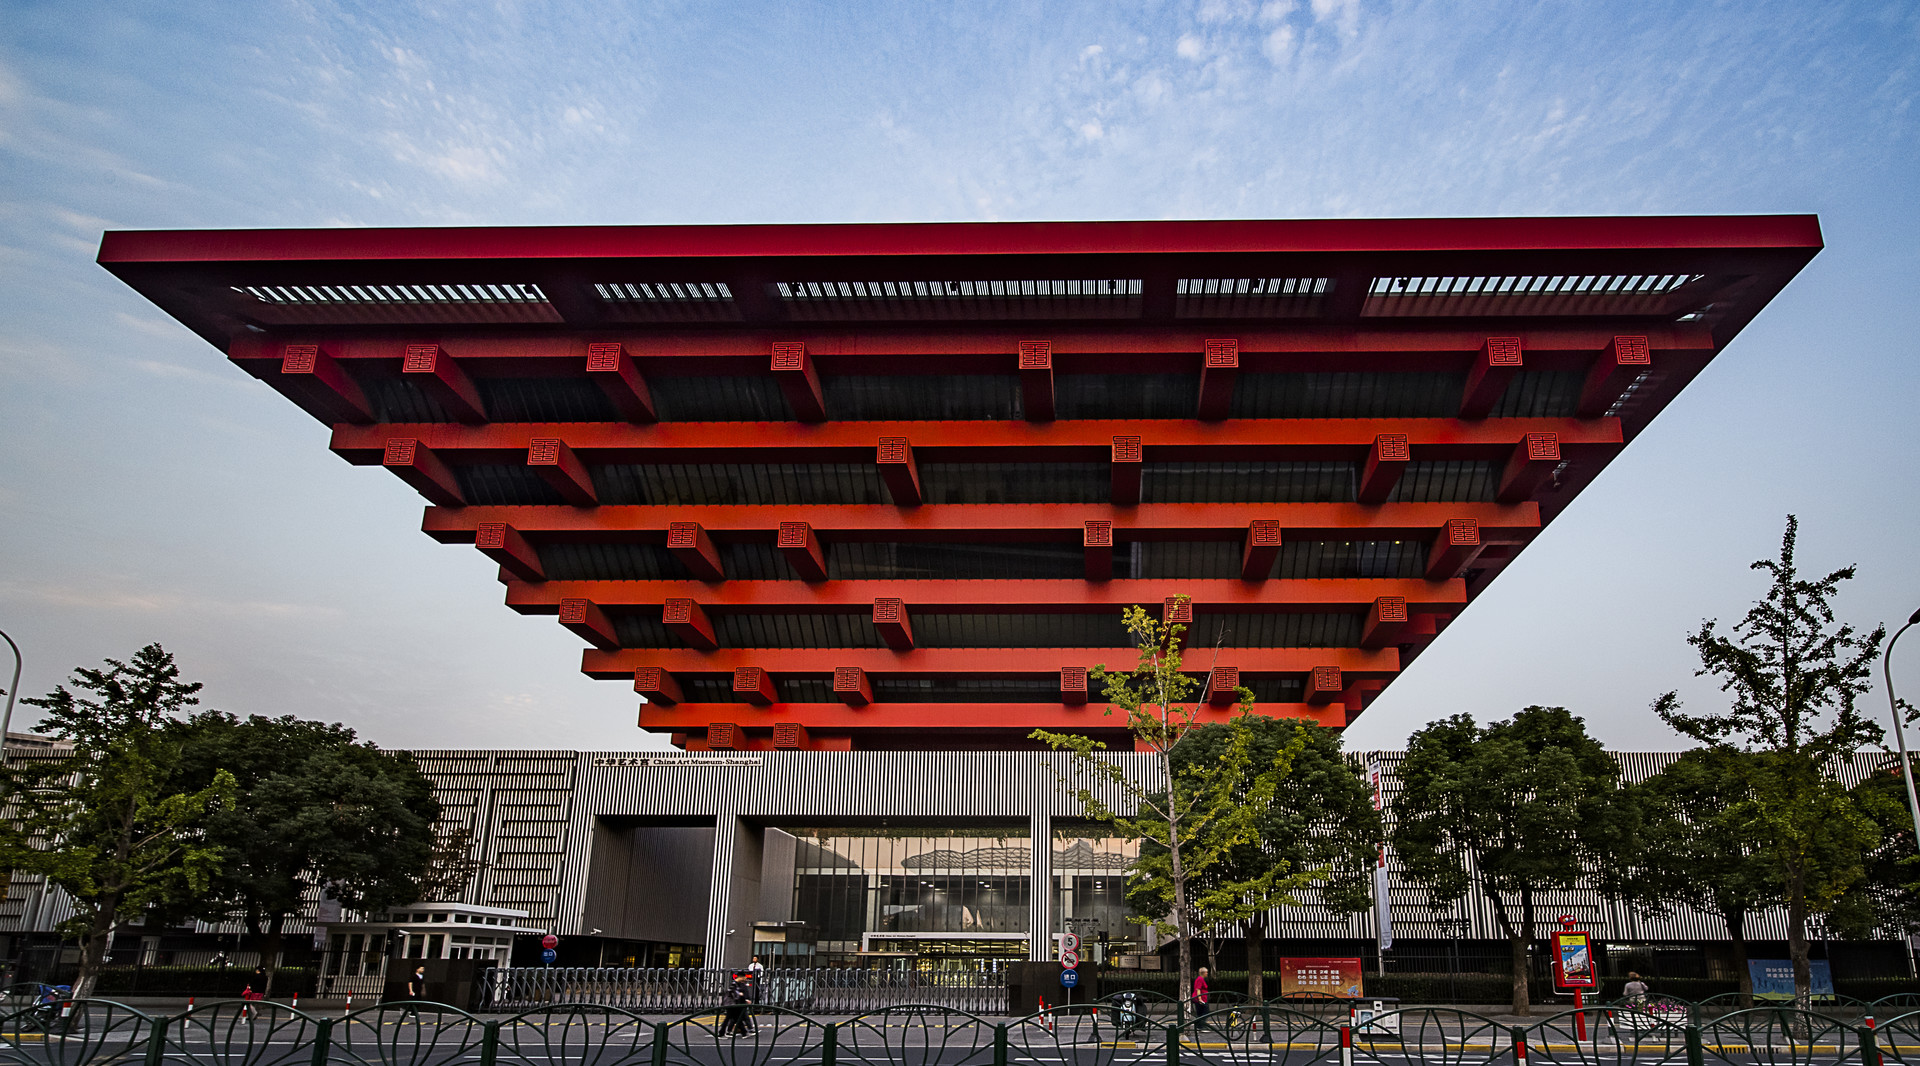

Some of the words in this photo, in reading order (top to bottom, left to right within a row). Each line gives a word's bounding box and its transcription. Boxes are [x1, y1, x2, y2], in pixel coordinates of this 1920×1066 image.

[594, 758, 650, 767] 中华艺术宫
[1067, 938, 1073, 946] 5
